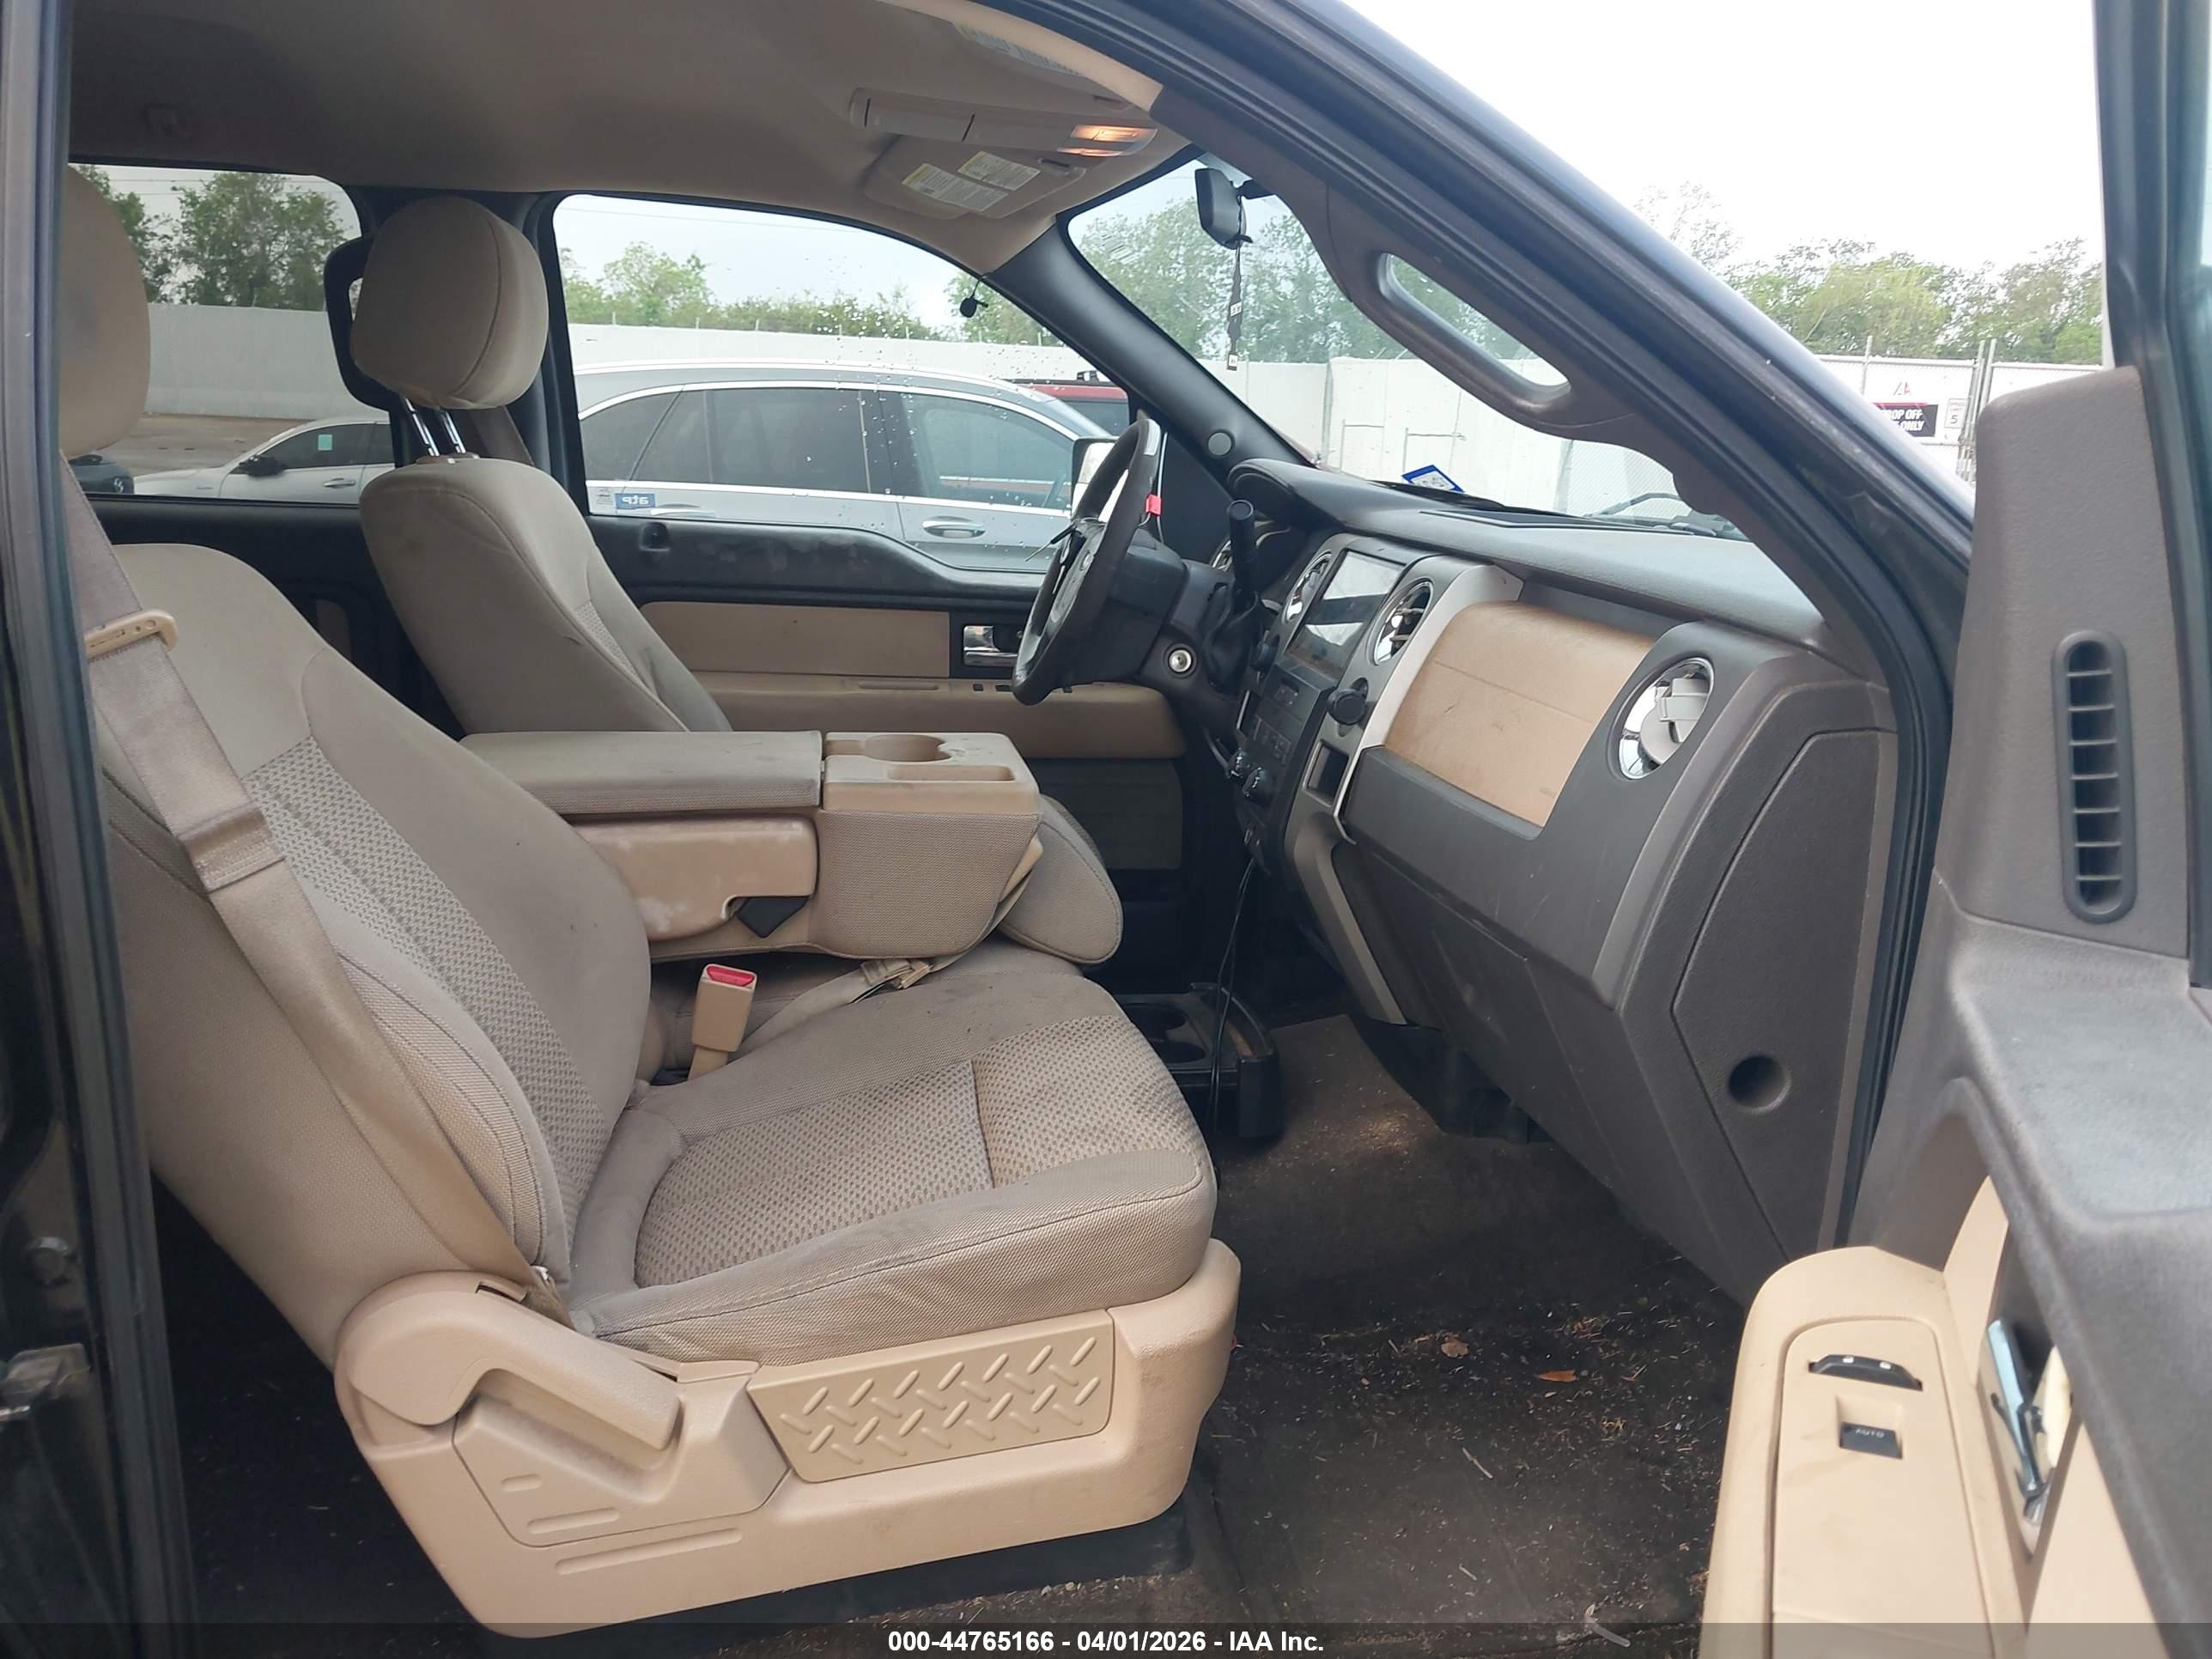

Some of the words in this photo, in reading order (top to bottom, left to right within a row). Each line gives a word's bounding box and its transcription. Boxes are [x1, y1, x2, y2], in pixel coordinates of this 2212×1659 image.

[1905, 410, 1923, 419] OFF
[1950, 415, 1959, 424] 5
[1900, 421, 1924, 431] ONLY
[1855, 1428, 1885, 1438] AUTO
